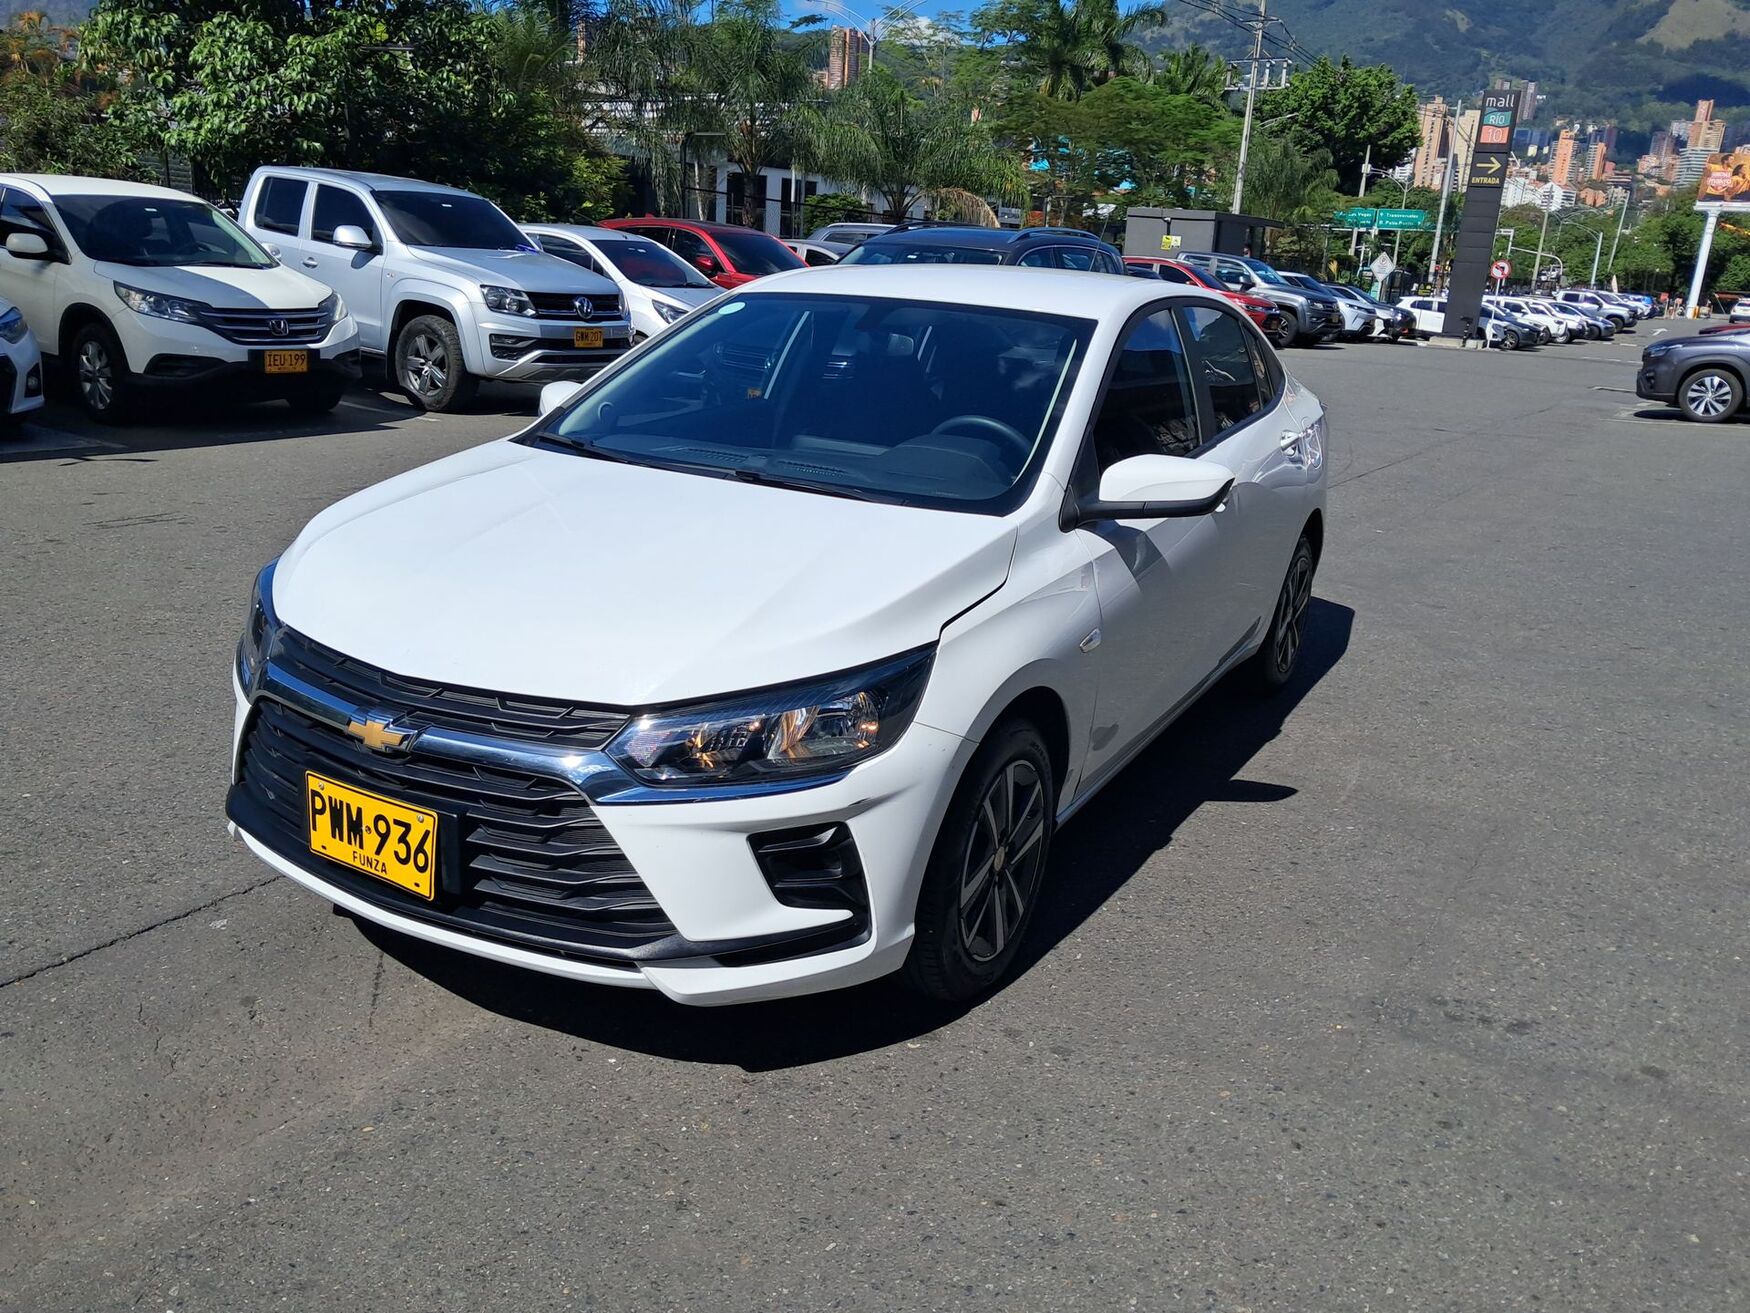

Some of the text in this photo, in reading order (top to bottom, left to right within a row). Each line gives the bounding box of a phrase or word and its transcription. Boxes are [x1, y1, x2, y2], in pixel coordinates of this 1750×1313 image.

[1486, 94, 1515, 107] mall
[1488, 128, 1502, 142] 10
[1471, 176, 1500, 184] ENTRADA
[267, 353, 306, 367] IEU 199
[310, 788, 431, 874] PWM 936
[352, 850, 388, 875] FUNZA
